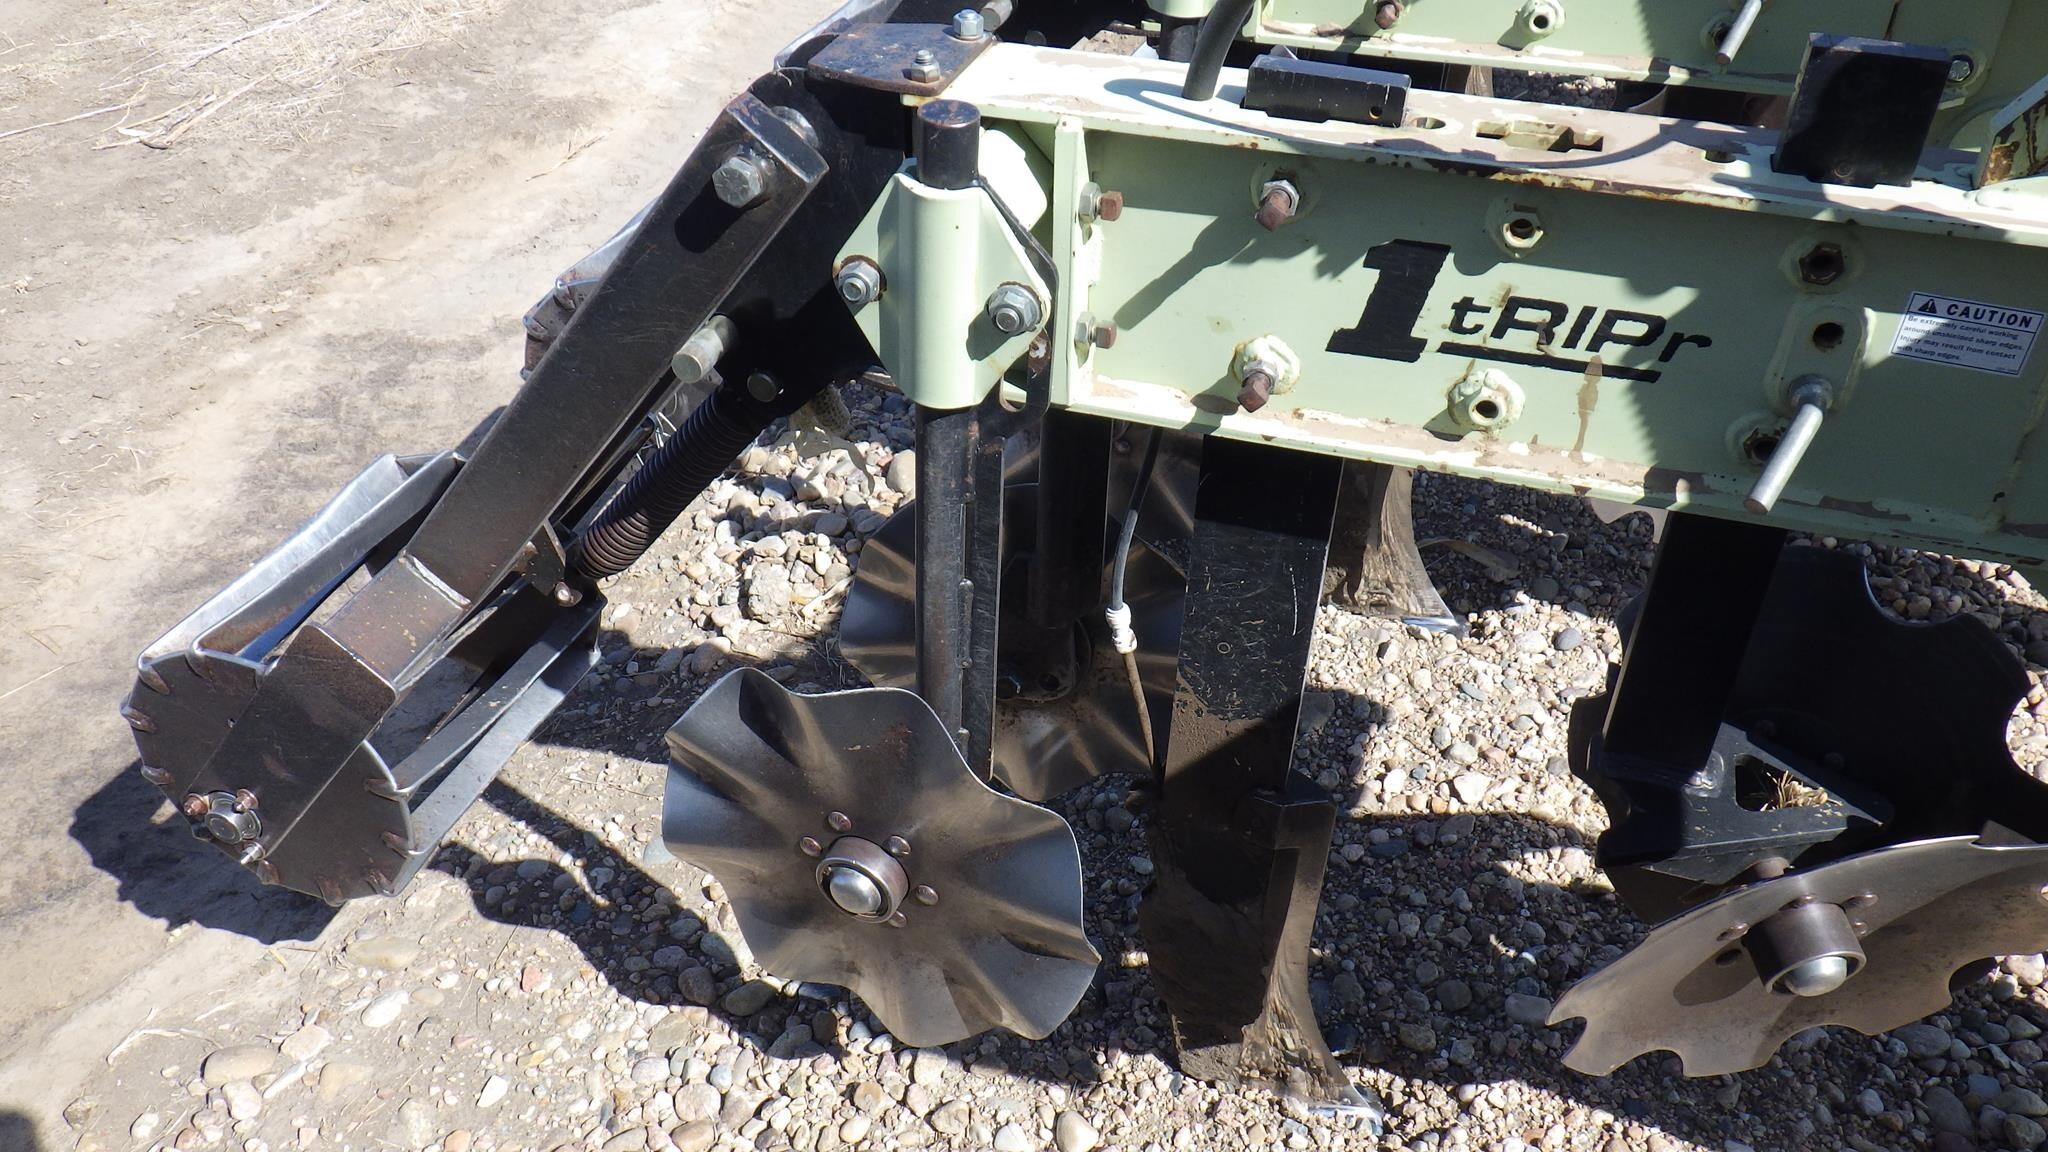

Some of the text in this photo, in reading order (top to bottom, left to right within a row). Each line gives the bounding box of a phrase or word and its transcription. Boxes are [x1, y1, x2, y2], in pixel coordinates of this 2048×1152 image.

[1326, 239, 1451, 363] 1
[1907, 315, 2020, 341] Be extremely careful working
[1946, 303, 2033, 328] CAUTION
[1900, 334, 2017, 360] Injury may result from contact
[1903, 326, 1931, 336] around
[1932, 330, 1974, 342] unshielded
[1975, 337, 1997, 347] sharp
[1896, 345, 1913, 353] with
[1914, 347, 1936, 357] sharp
